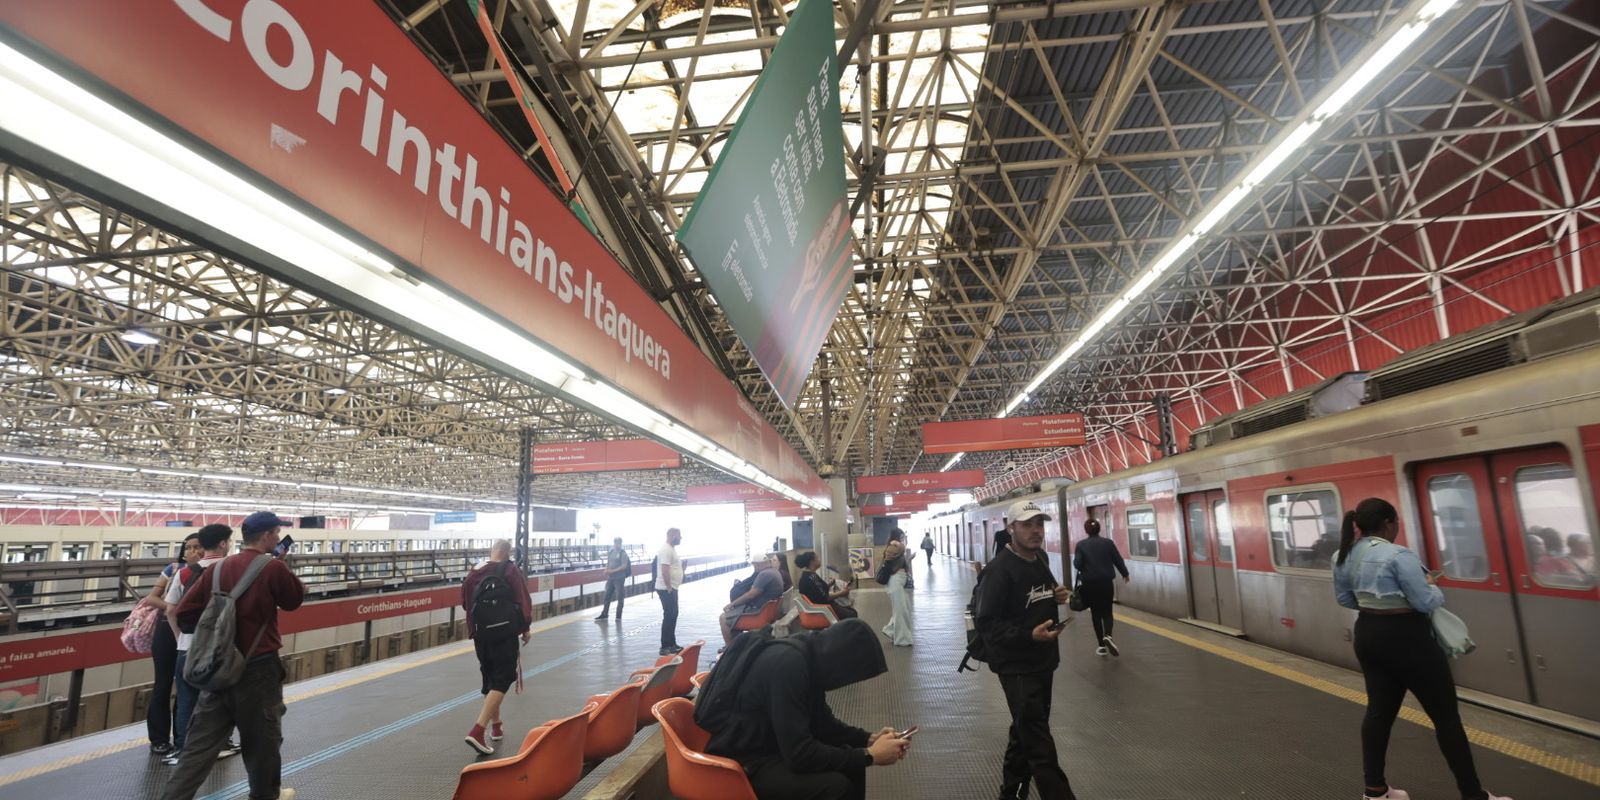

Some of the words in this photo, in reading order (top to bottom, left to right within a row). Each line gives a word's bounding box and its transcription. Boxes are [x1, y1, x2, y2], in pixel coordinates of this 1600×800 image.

[807, 85, 818, 123] sua
[818, 55, 830, 111] Para
[795, 109, 808, 142] ser
[811, 117, 826, 172] marca
[770, 157, 780, 177] a
[783, 133, 799, 183] conte
[792, 179, 806, 214] com
[801, 138, 813, 184] vista,
[170, 0, 671, 380] orinthians-Itaquera
[357, 597, 432, 614] Corinthians-Itaquera
[9, 652, 34, 663] faixa
[36, 646, 77, 658] amarela.
